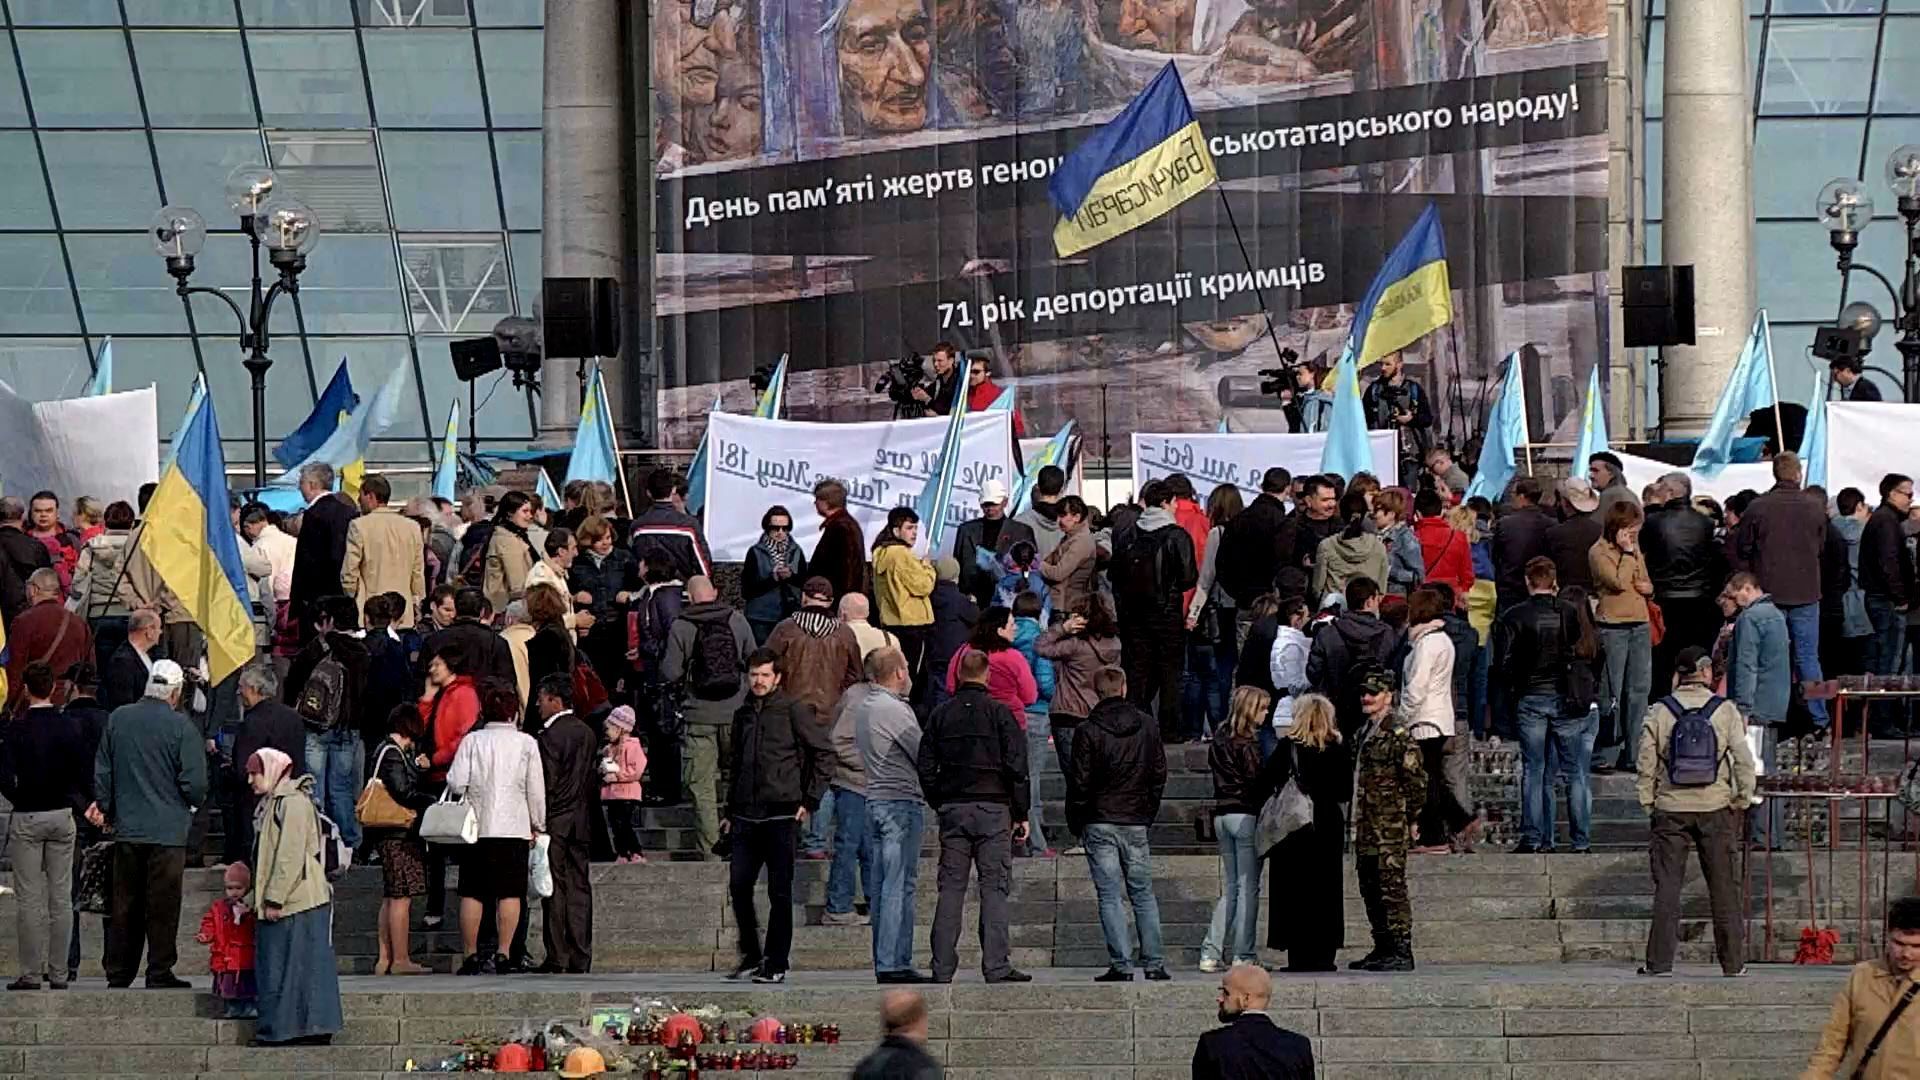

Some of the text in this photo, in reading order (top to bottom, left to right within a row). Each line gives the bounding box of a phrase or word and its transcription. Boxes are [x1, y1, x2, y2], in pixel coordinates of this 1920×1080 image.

[685, 196, 760, 230] День
[882, 168, 975, 199] жертв
[1209, 108, 1452, 156] ськотатарського
[1461, 83, 1580, 127] народу!
[937, 258, 1326, 330] 71 рік депортації кримців
